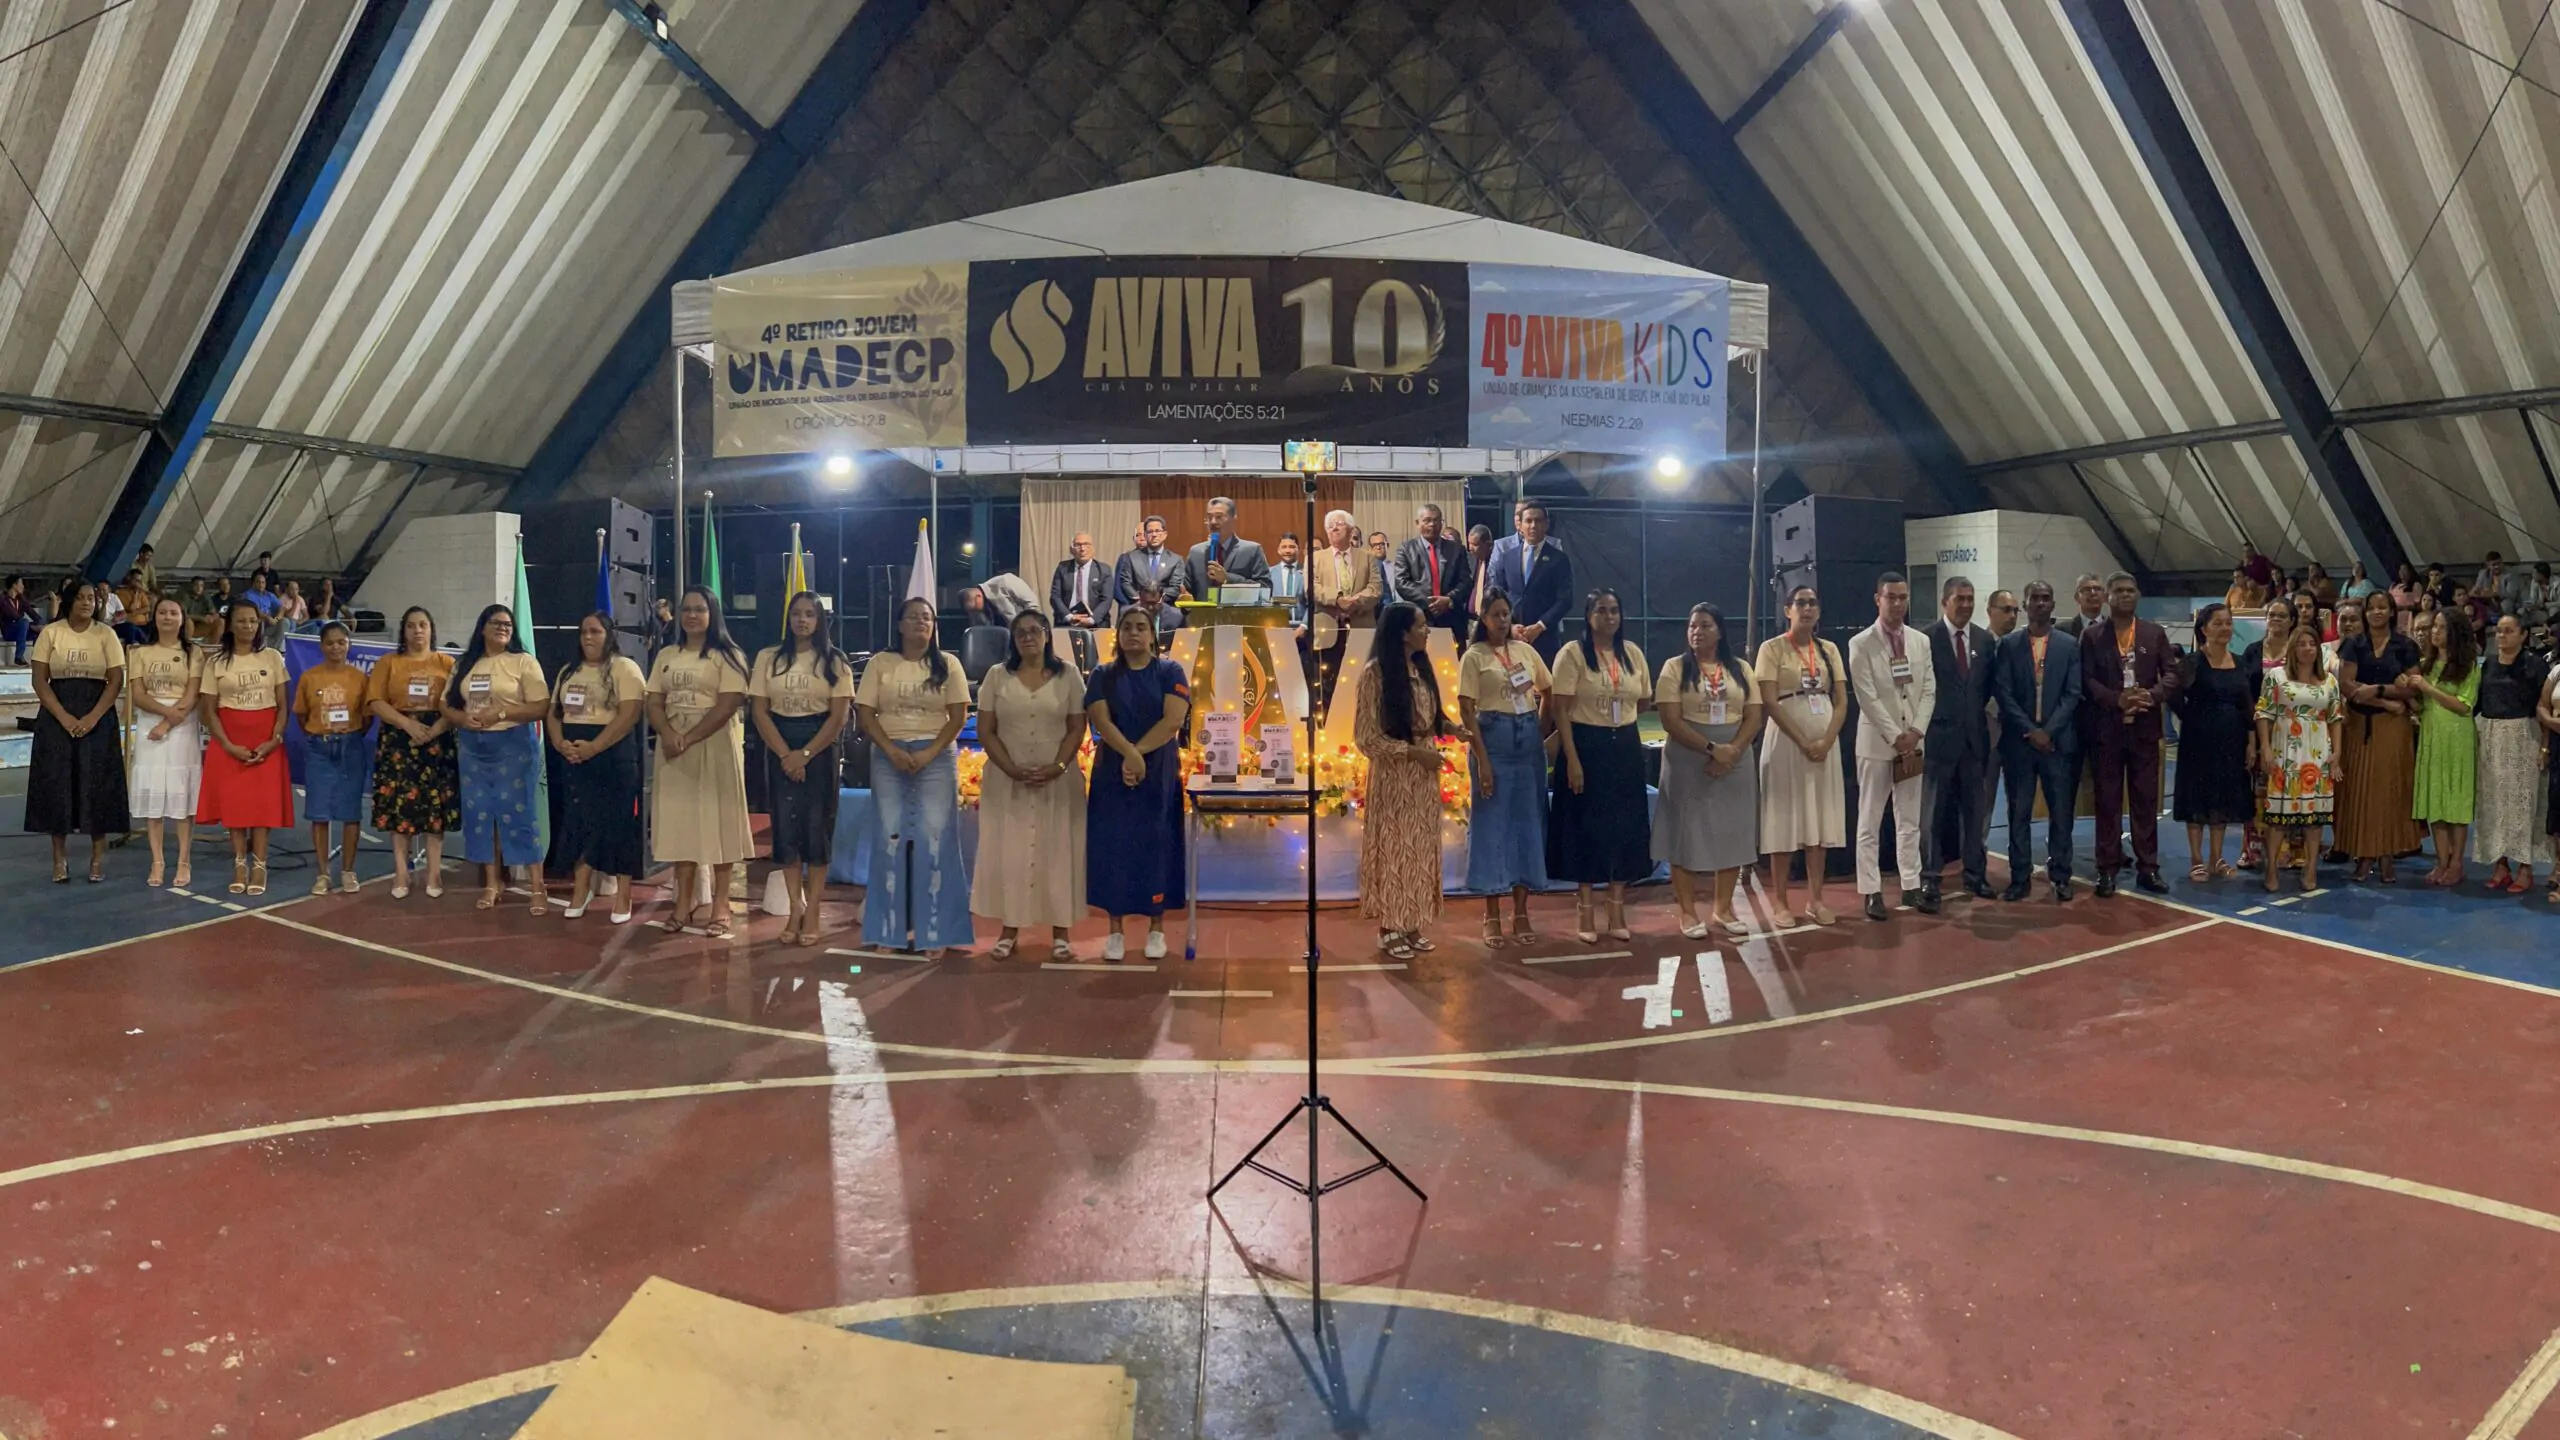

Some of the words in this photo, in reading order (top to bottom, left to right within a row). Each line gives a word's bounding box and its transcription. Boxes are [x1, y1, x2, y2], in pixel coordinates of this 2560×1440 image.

[761, 323, 781, 344] 4º
[786, 318, 848, 343] RETIRO
[853, 314, 917, 337] JOVEM
[1082, 277, 1261, 378] AVIVA
[1281, 277, 1429, 376] 10
[1521, 314, 1626, 384] AVIVA
[1633, 321, 1713, 389] KIDS
[728, 337, 956, 395] UMADECP
[1145, 383, 1171, 392] DO
[1189, 383, 1259, 392] PILAR
[1340, 375, 1440, 395] ANOS
[1509, 382, 1519, 396] DE
[1521, 382, 1557, 399] CRIANÇAS
[1147, 402, 1254, 423] LAMENTAÇÕES
[1257, 406, 1286, 420] 5:21
[1561, 411, 1615, 429] NEEMIAS
[1936, 543, 1978, 563] VESTIÁRIO-2
